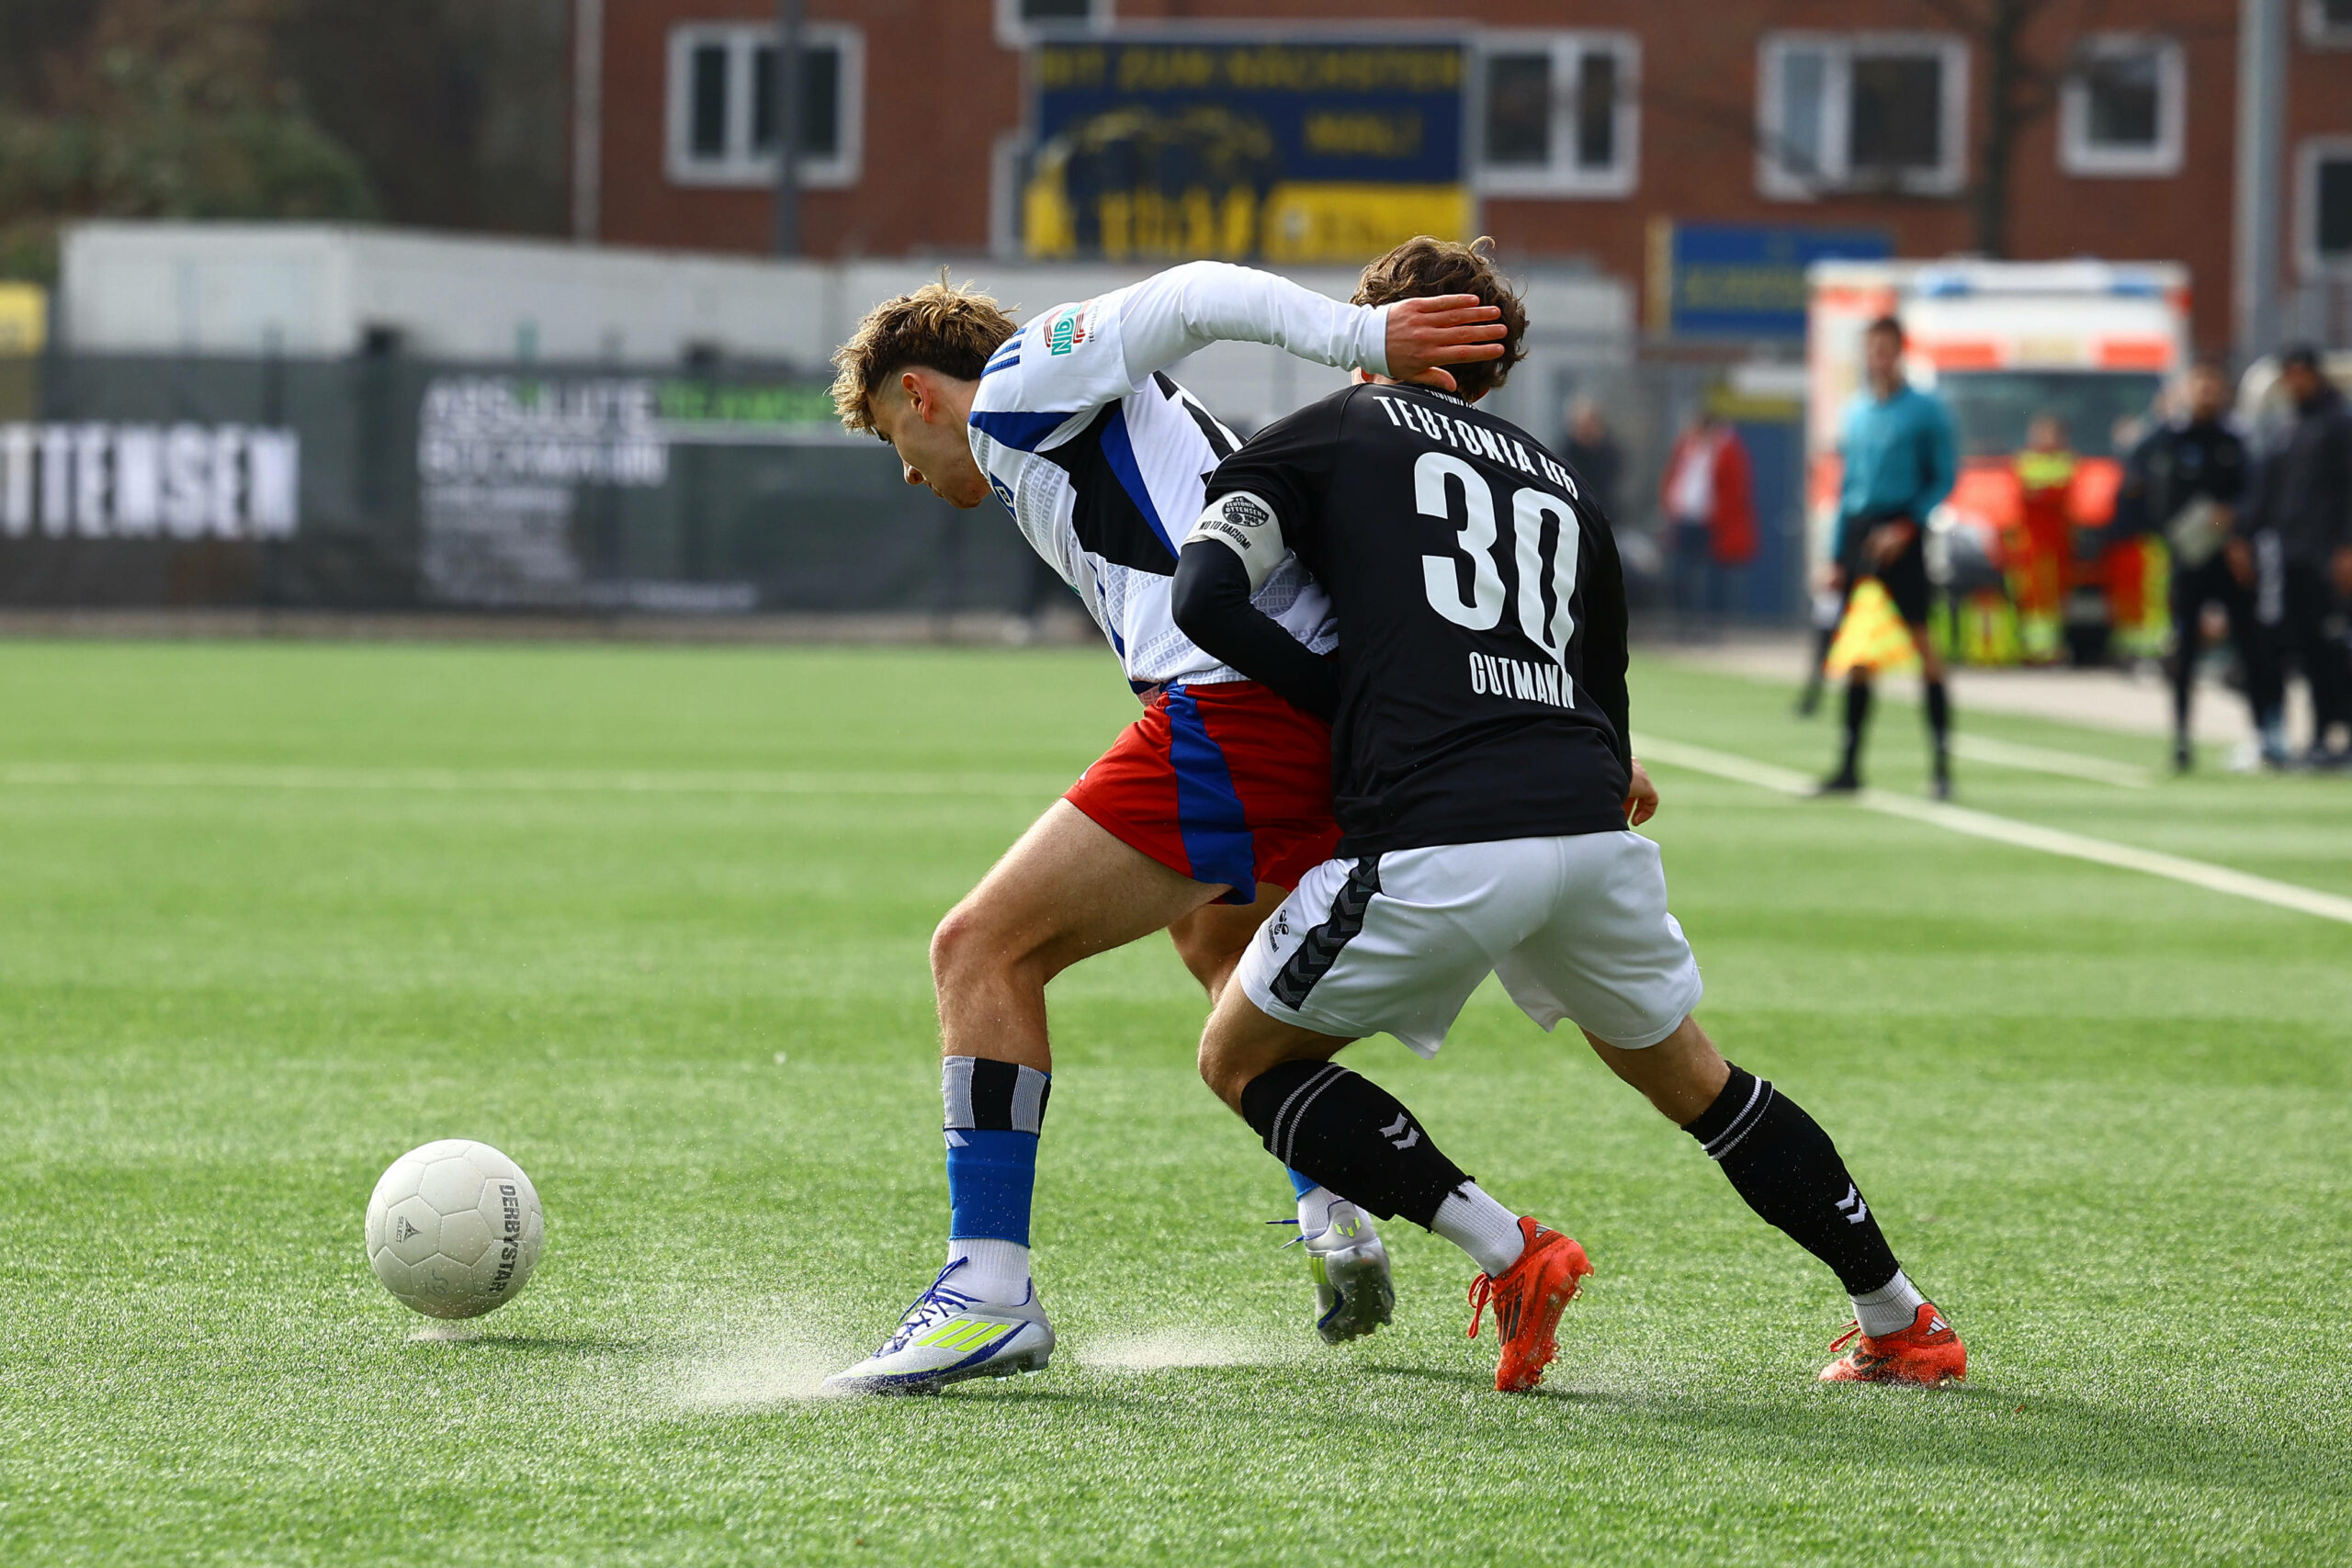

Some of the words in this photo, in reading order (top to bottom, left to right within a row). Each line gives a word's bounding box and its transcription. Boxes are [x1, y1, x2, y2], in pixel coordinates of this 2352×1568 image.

[1373, 396, 1539, 477] TEUTONIA
[1199, 521, 1211, 530] NO
[1210, 521, 1221, 530] TO
[1220, 522, 1251, 550] RACISM!
[1225, 506, 1263, 518] OTTENSEN
[1413, 451, 1581, 675] 30
[1469, 651, 1576, 709] GUTMANN
[396, 1215, 404, 1244] SELECT
[488, 1183, 521, 1292] DERBYSTAR
